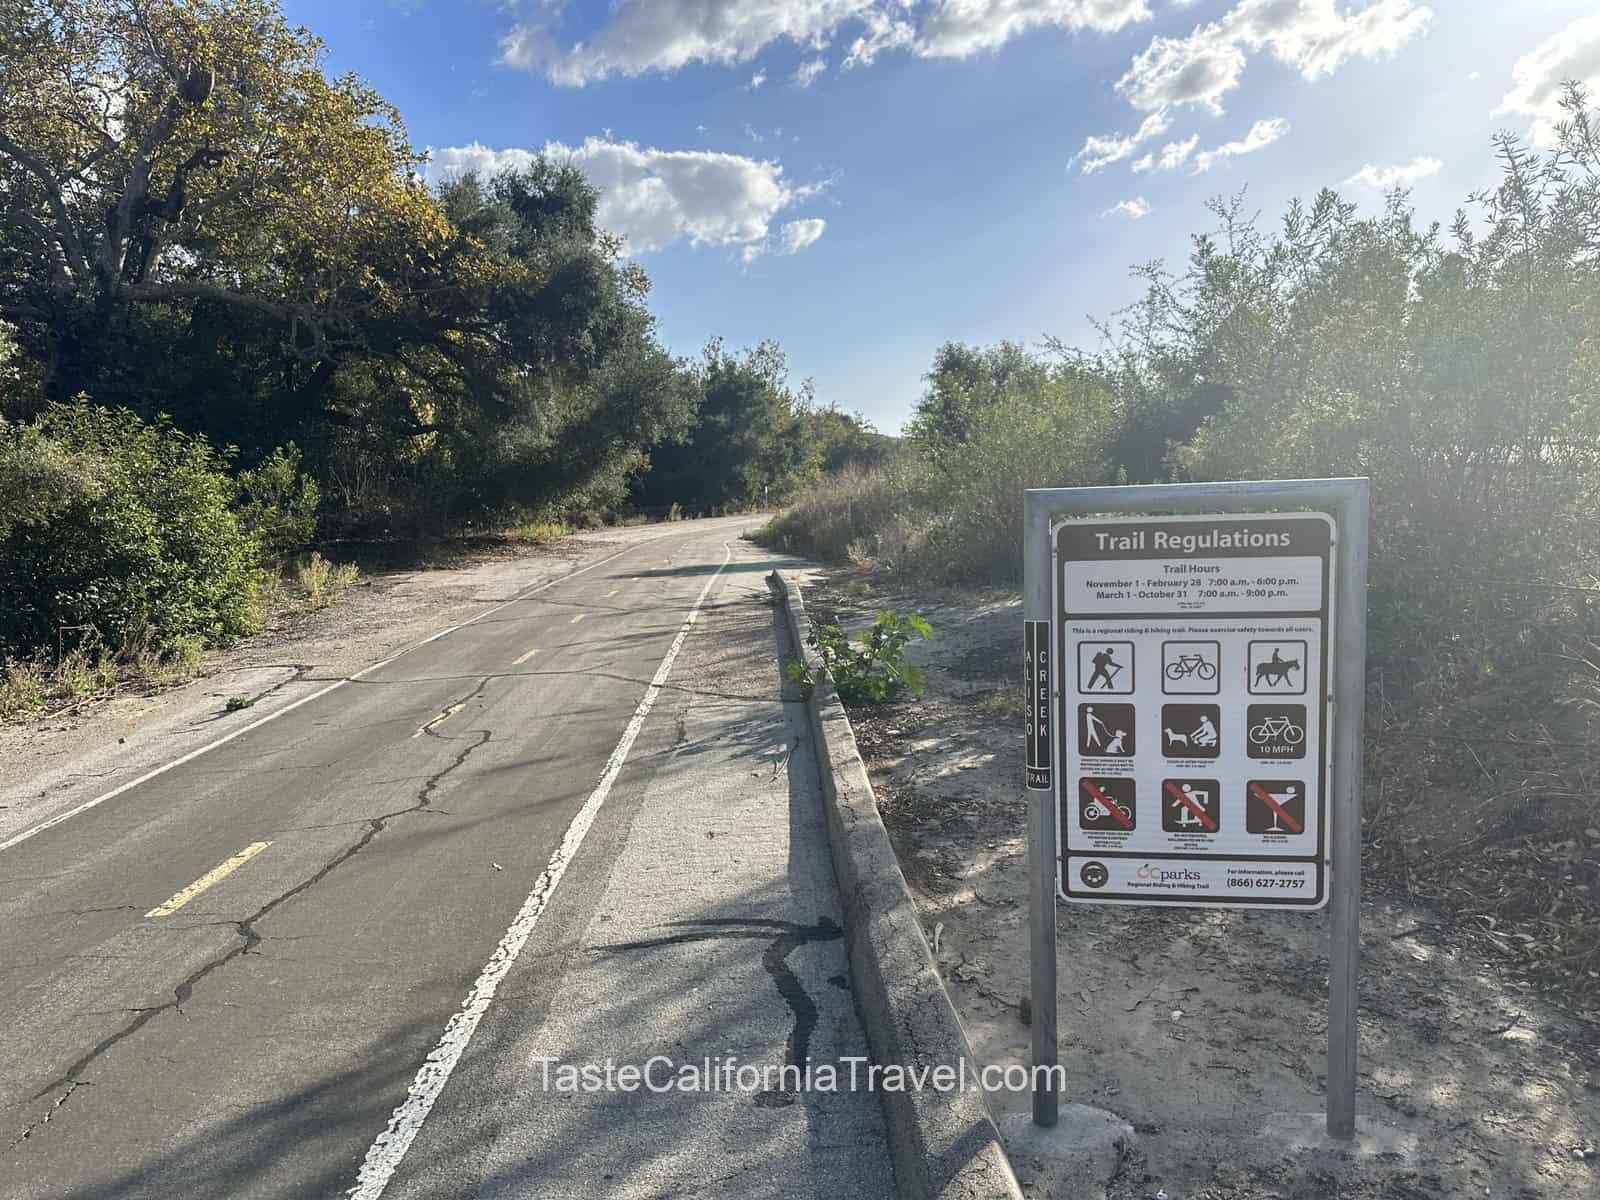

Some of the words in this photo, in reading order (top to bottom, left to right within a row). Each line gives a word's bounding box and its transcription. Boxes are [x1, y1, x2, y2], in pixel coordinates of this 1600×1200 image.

[1095, 531, 1145, 550] Trail
[1154, 529, 1291, 553] Regulations
[1163, 564, 1187, 573] Trail
[1189, 564, 1221, 573] Hours
[1086, 580, 1132, 588] November
[1147, 579, 1188, 588] February
[1208, 578, 1228, 586] 7:00
[1278, 578, 1299, 587] p.m.
[1096, 591, 1124, 599] March
[1138, 590, 1175, 599] October
[1176, 590, 1187, 598] 31
[1246, 589, 1266, 597] 9:00
[1267, 589, 1288, 598] p.m.
[1150, 627, 1170, 635] hiking
[1237, 626, 1257, 634] safety
[1025, 651, 1033, 735] ALISO
[1039, 651, 1048, 737] CREEK
[1260, 745, 1271, 753] 10
[1272, 745, 1294, 753] MPH
[1026, 772, 1049, 784] TRAIL
[1177, 882, 1196, 890] Hiking
[1226, 878, 1254, 888] (866)
[1255, 879, 1305, 888] 627-2757
